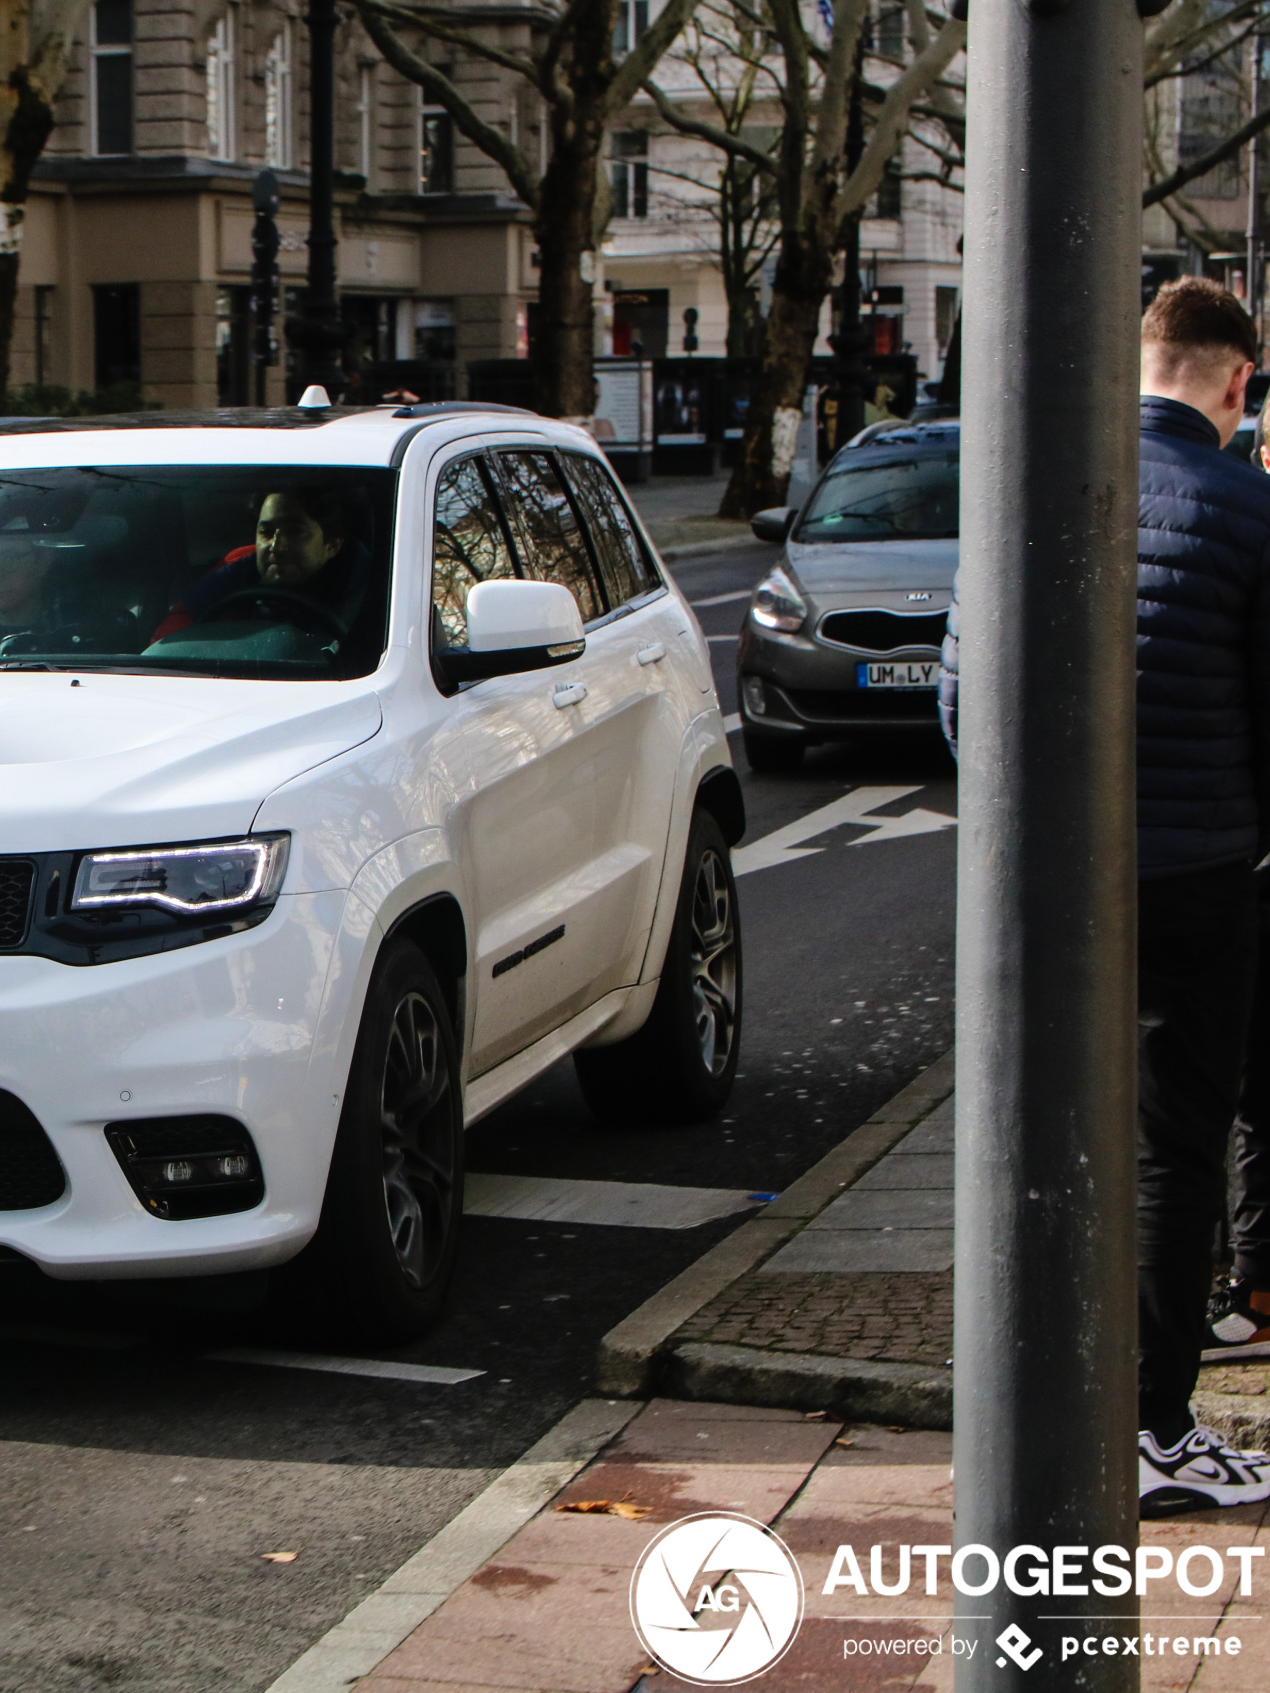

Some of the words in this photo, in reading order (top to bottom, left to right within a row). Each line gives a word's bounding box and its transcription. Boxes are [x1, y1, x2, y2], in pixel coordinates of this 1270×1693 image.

[907, 592, 932, 601] KIA
[869, 665, 894, 684] UM
[908, 665, 932, 683] LY
